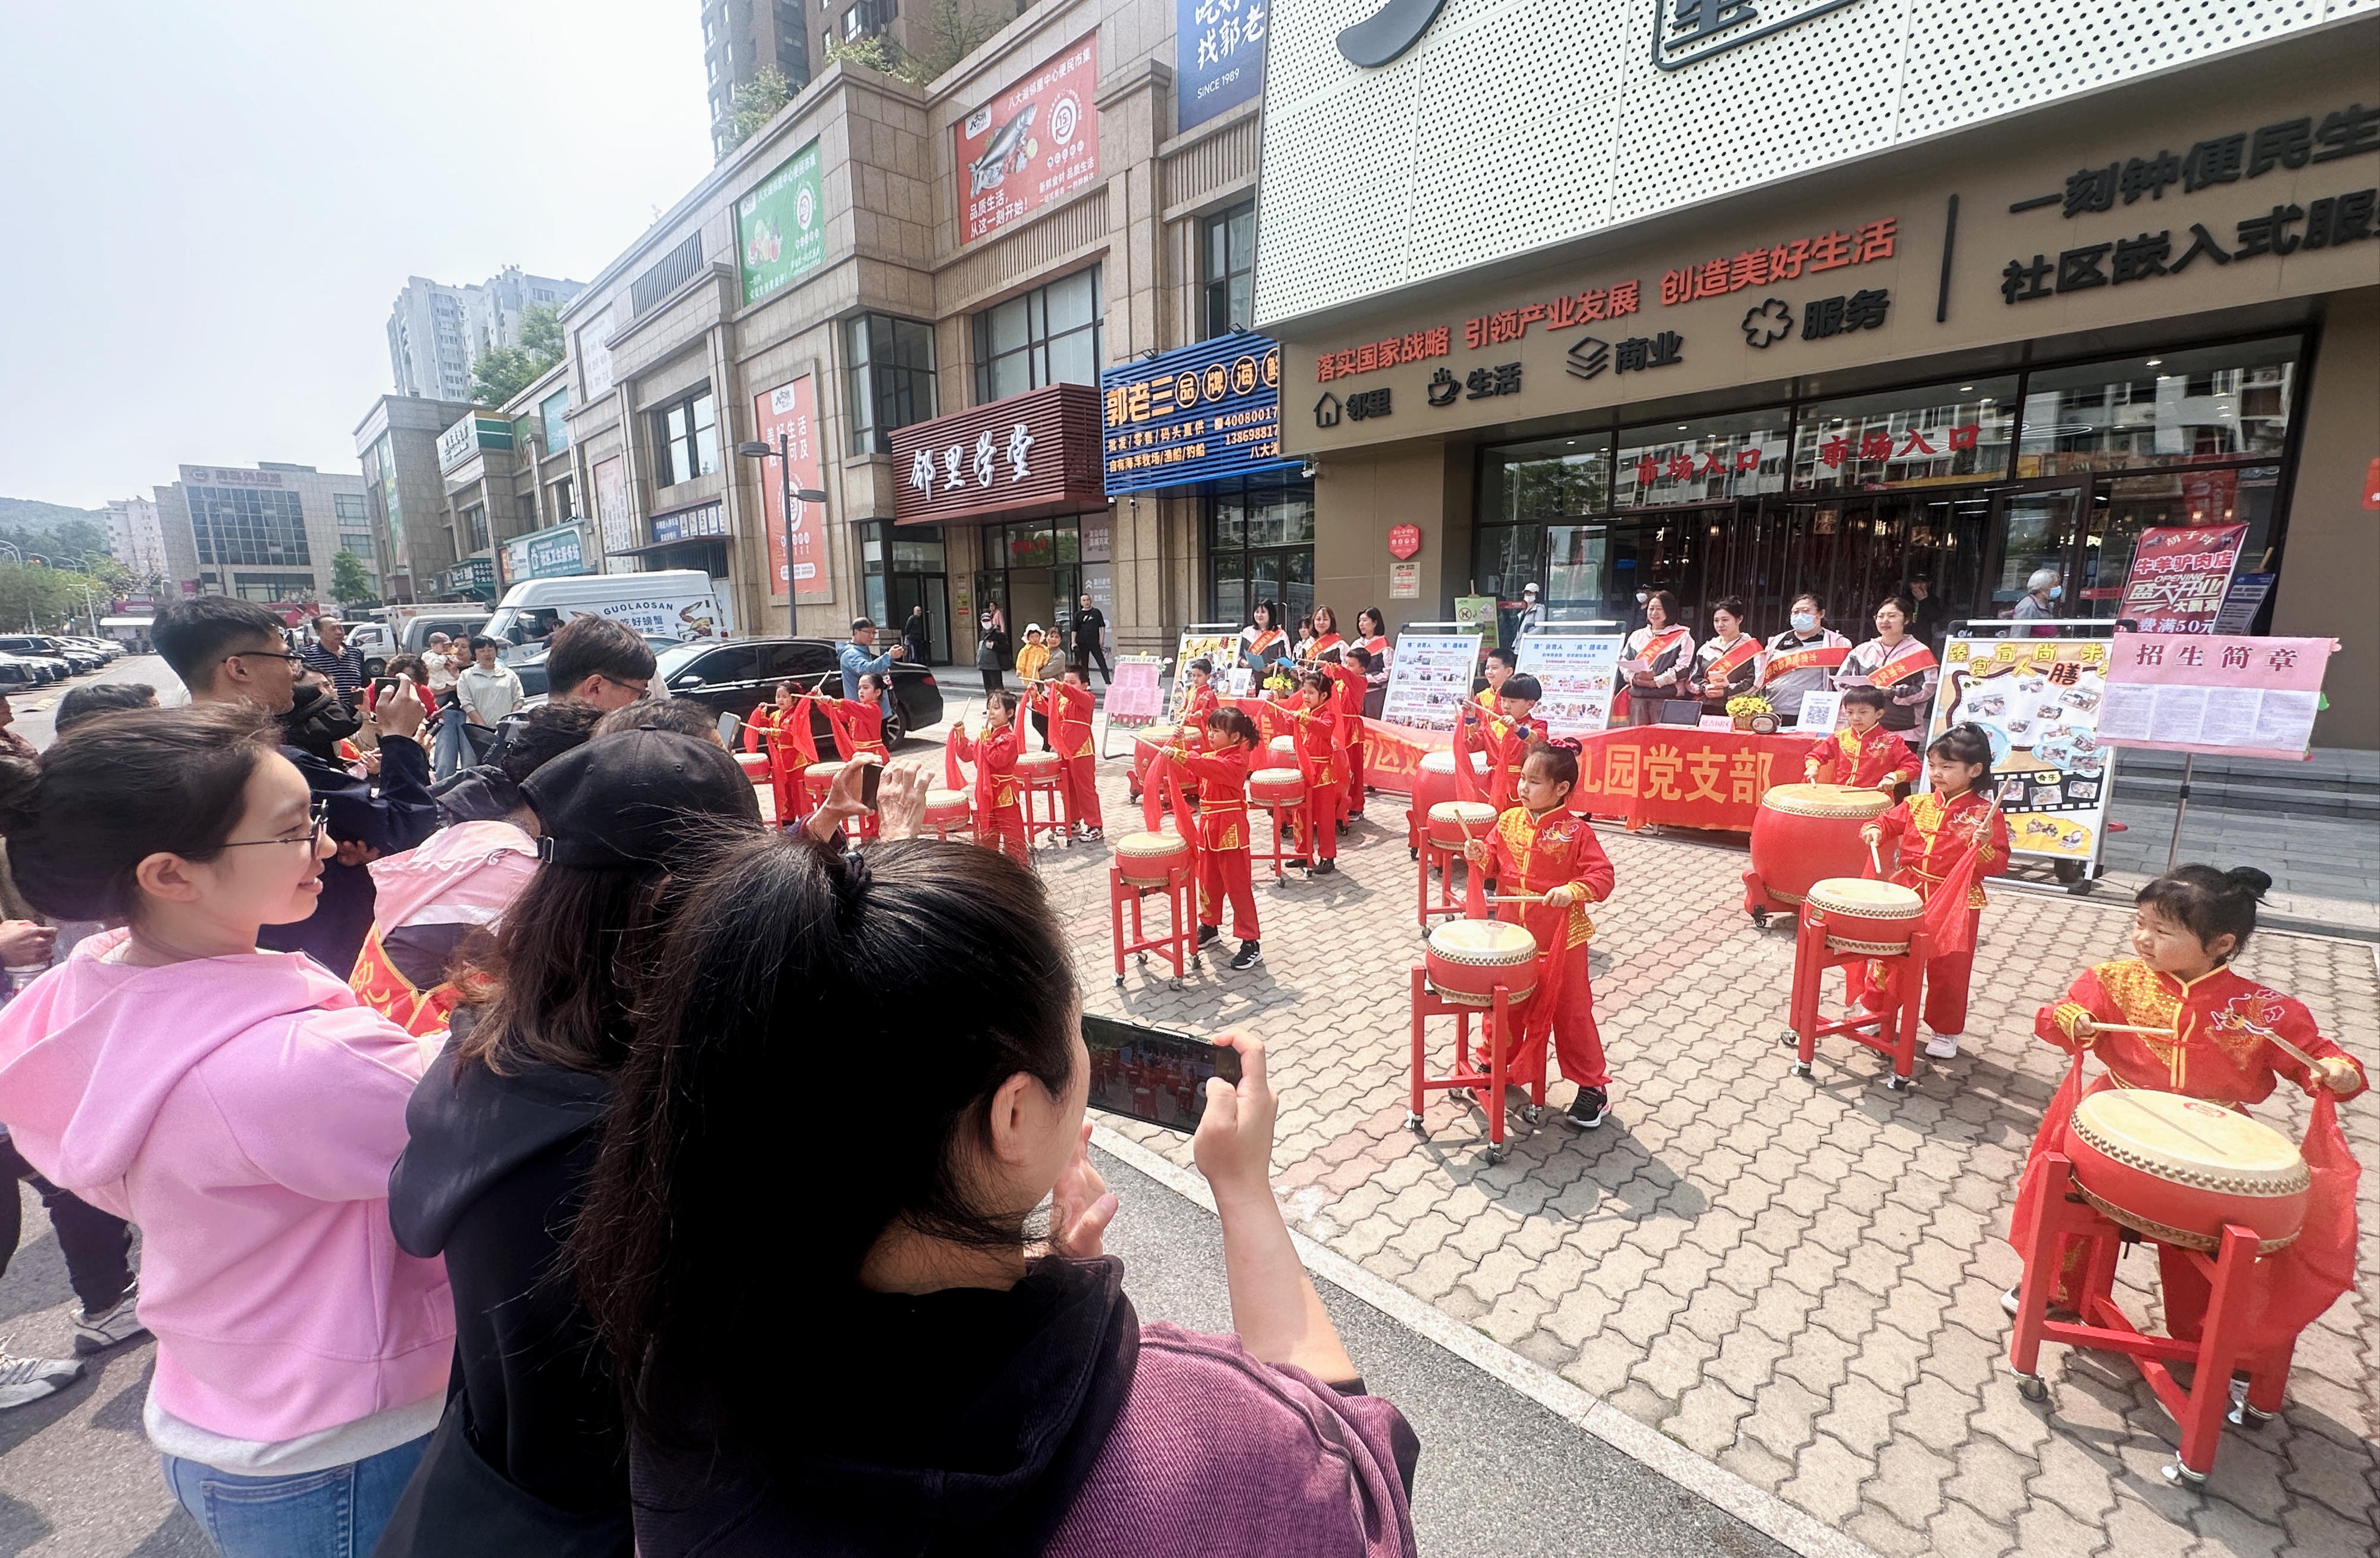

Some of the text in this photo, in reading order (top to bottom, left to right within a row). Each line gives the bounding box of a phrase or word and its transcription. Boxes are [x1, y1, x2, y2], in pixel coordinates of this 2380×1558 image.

[1197, 2, 1265, 71] 找郭老
[1008, 47, 1091, 110] 八大湖邻里中心便民市集
[1197, 68, 1240, 99] SINCE 1989
[2009, 104, 2380, 219] 一刻钟便民生
[2001, 189, 2380, 305] 社区嵌入式服
[1315, 215, 1899, 383] 落实国家战略 引领产业发展 创造美好生活
[1345, 287, 1892, 422] 邻里 生活 商业 服务
[1106, 375, 1175, 427] 郭老三
[909, 424, 1035, 500] 邻里学堂
[1635, 447, 1762, 488] 市场入口
[1818, 423, 1981, 470] 市场入口
[2134, 550, 2235, 575] 牛羊驴肉店
[2154, 572, 2207, 583] OPENING
[604, 602, 674, 615] GUOLAOSAN
[2127, 577, 2225, 605] 盛大开业
[2118, 618, 2216, 635] 费满50元
[2135, 643, 2298, 672] 招生简章
